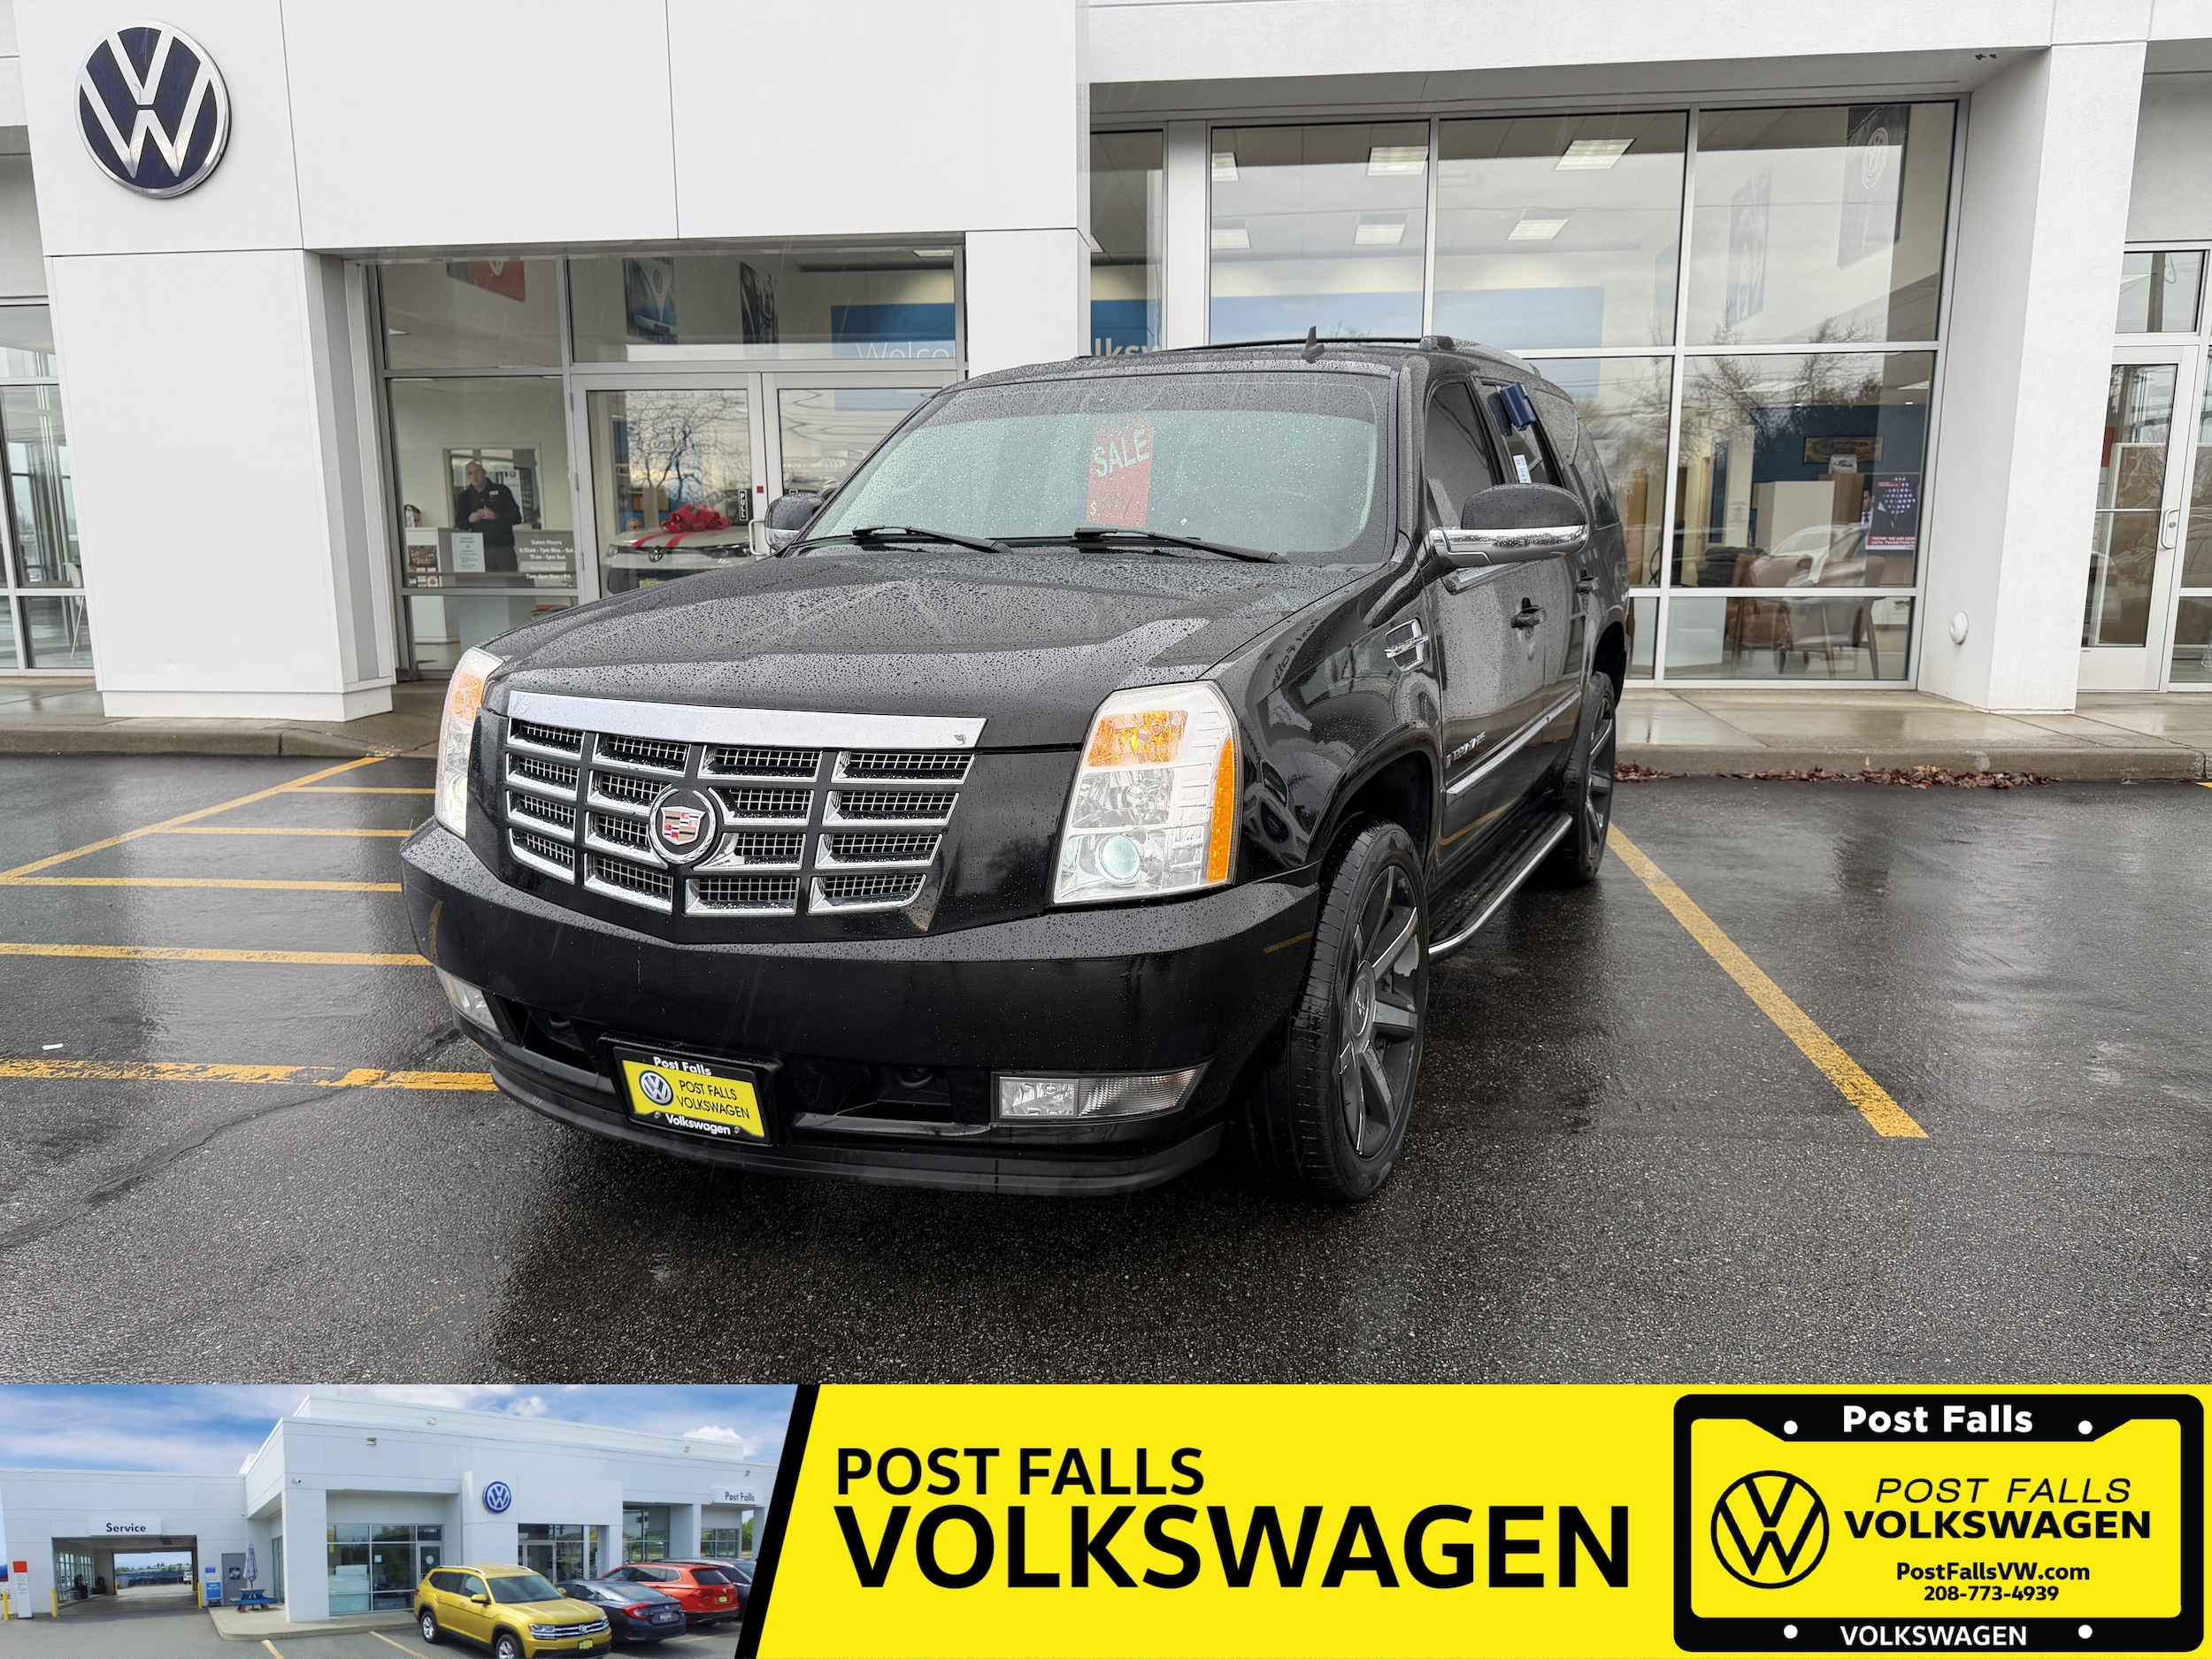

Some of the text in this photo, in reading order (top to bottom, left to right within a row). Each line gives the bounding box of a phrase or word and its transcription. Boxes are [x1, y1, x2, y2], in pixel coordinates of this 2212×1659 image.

[855, 341, 956, 358] Welco
[1093, 428, 1150, 477] SALE
[652, 1056, 711, 1076] Post Falls
[679, 1079, 737, 1101] POST FALLS
[676, 1094, 750, 1119] VOLKSWAGEN
[665, 1113, 731, 1135] Volkswagen
